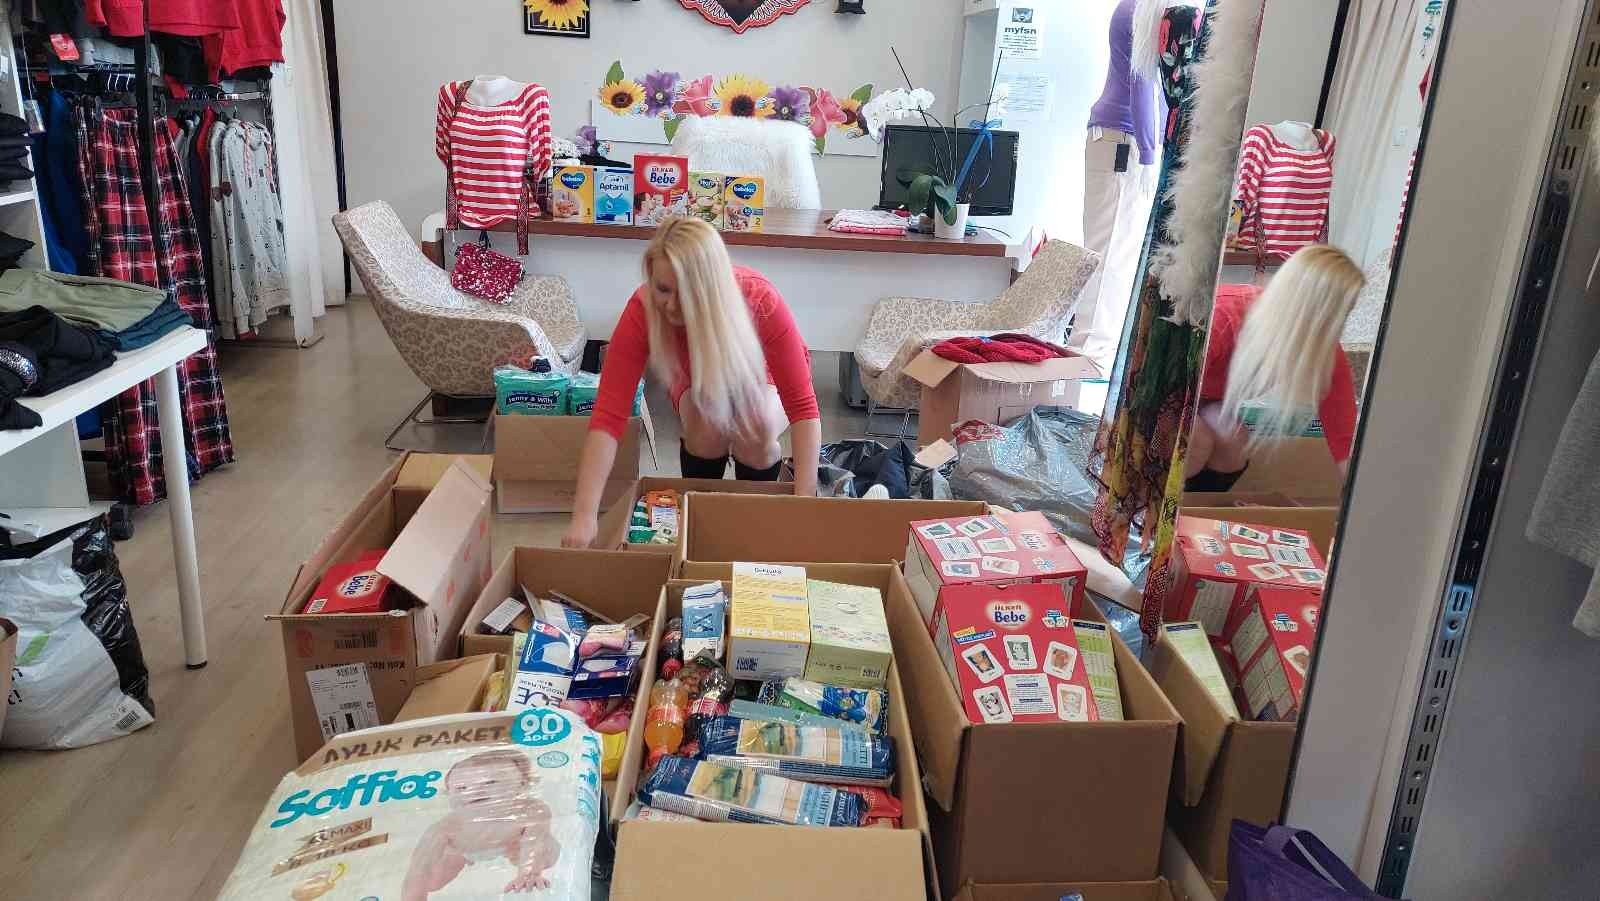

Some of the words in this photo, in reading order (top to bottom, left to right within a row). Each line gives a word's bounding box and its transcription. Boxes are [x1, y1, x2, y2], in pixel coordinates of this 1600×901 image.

[650, 172, 676, 184] Bebe
[599, 182, 629, 192] Aptamil
[344, 575, 369, 596] Bebe
[994, 611, 1027, 623] Bebe
[520, 713, 564, 736] 90
[412, 726, 506, 748] PAKET
[523, 734, 556, 742] ADET
